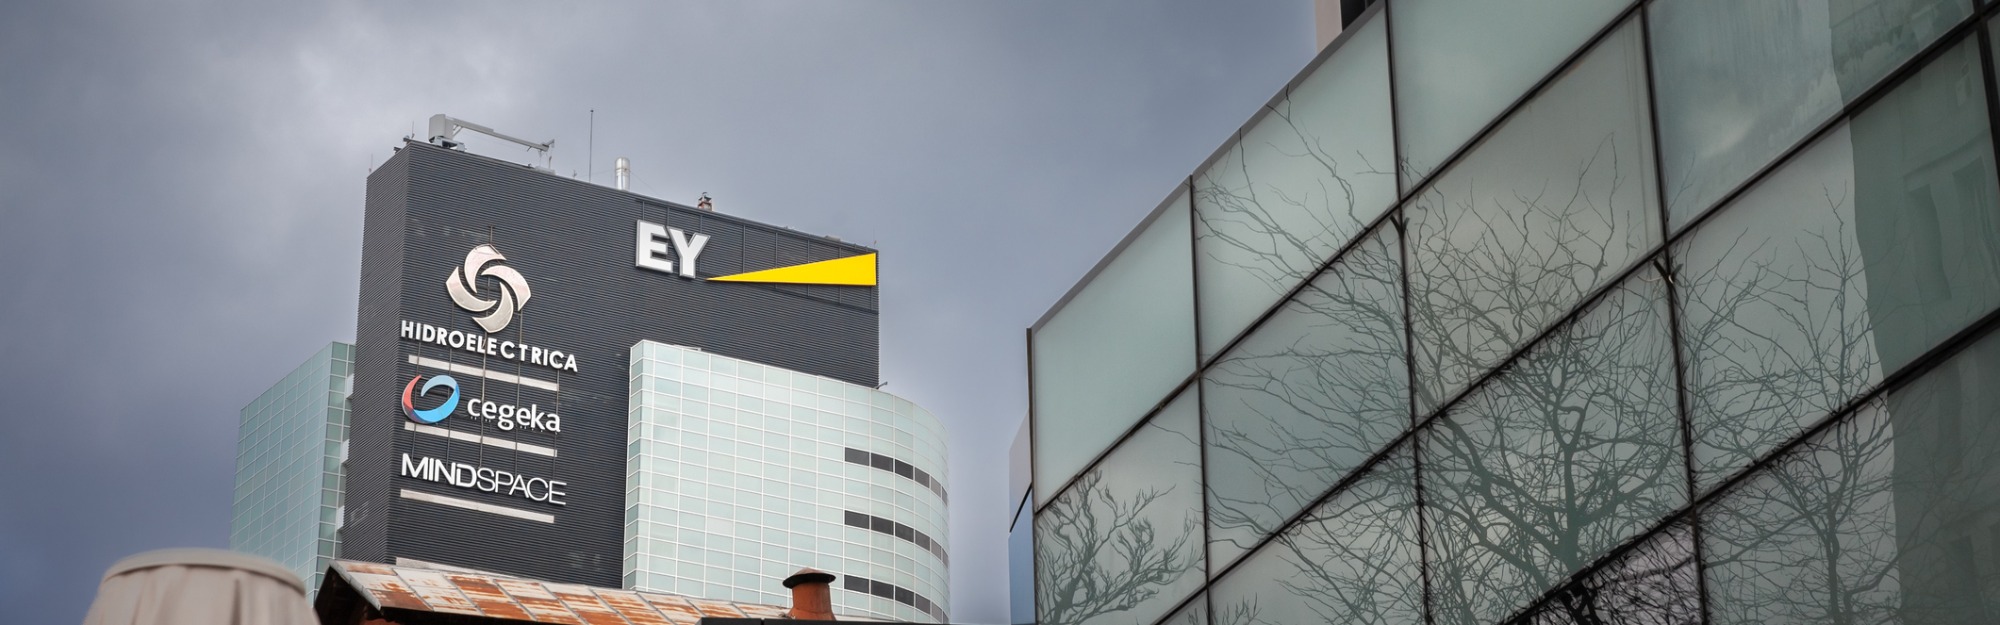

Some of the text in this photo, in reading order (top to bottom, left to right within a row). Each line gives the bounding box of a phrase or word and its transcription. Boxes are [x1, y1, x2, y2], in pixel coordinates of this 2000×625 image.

[635, 219, 711, 278] EY
[400, 320, 578, 372] HIDROELECTRICA
[467, 398, 561, 432] cegeka
[401, 453, 567, 505] MINDSPACE
